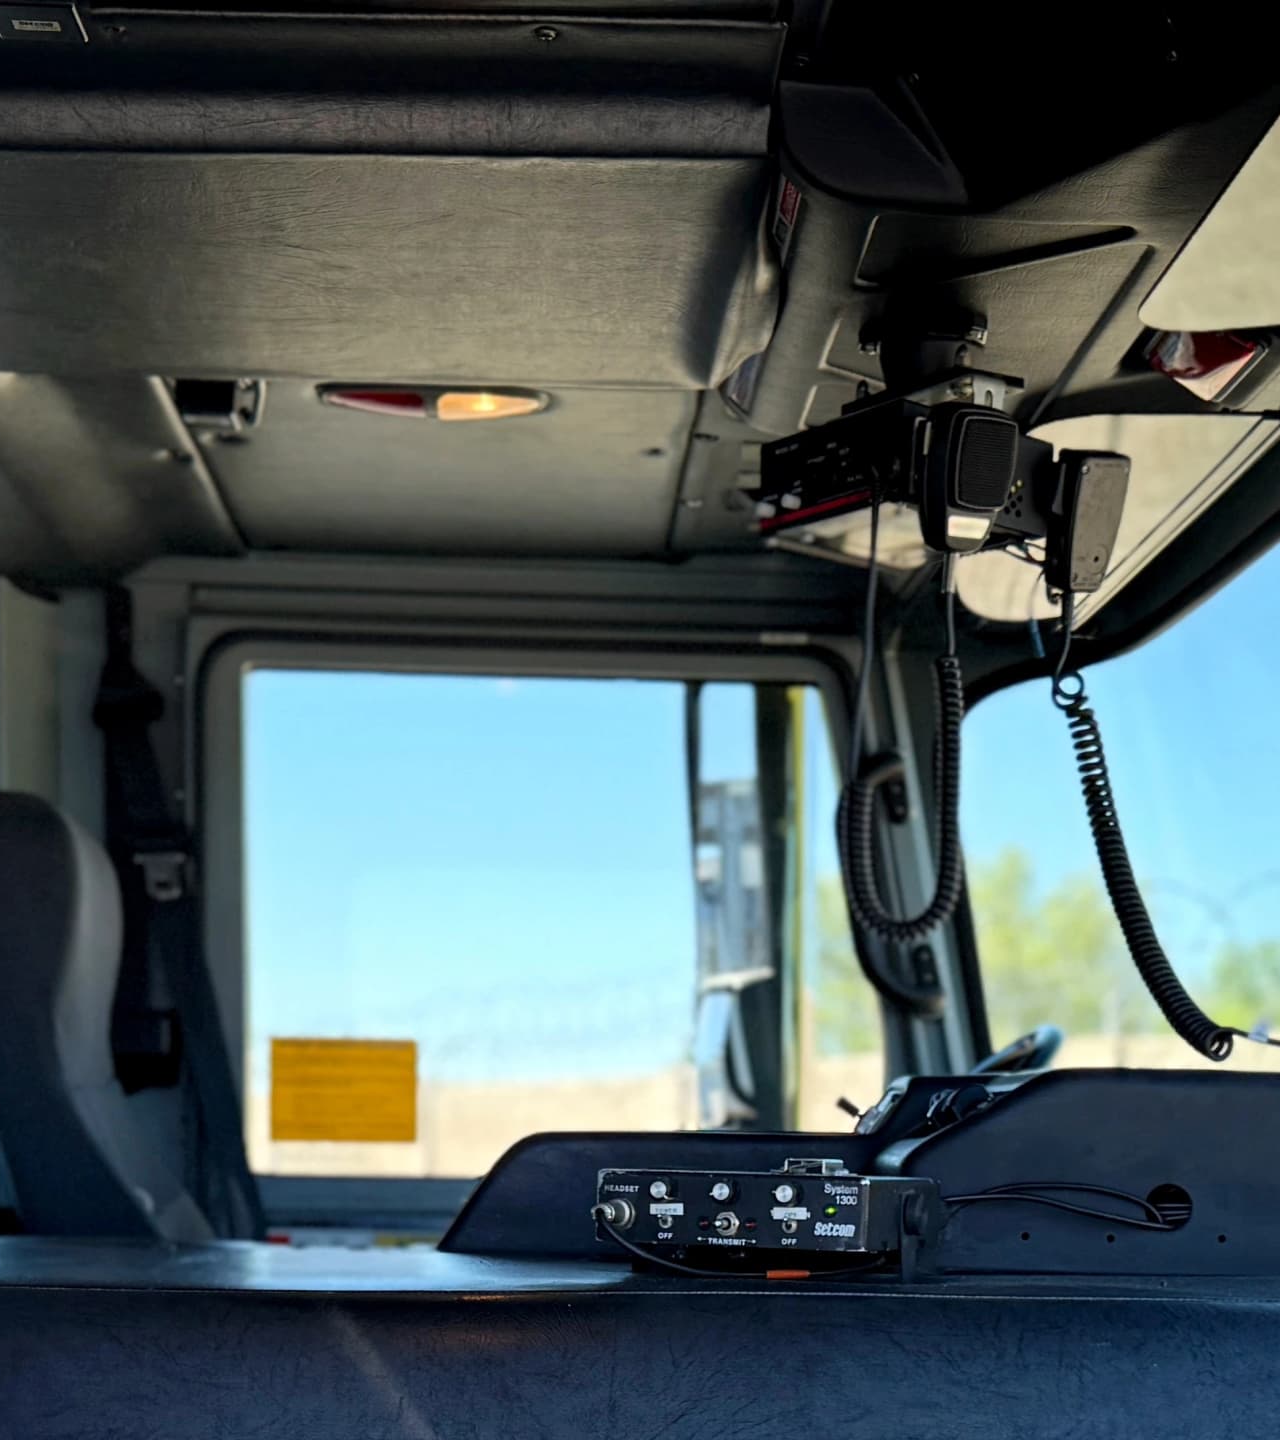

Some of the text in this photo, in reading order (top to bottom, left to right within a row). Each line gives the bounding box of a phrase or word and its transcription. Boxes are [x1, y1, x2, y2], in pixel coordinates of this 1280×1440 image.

[604, 1184, 640, 1194] HEADSET
[824, 1183, 859, 1197] System
[835, 1195, 858, 1206] 1300
[814, 1222, 856, 1237] Setcom
[657, 1232, 673, 1240] OFF
[708, 1237, 746, 1246] TRANSMIT
[781, 1238, 797, 1246] OFF
